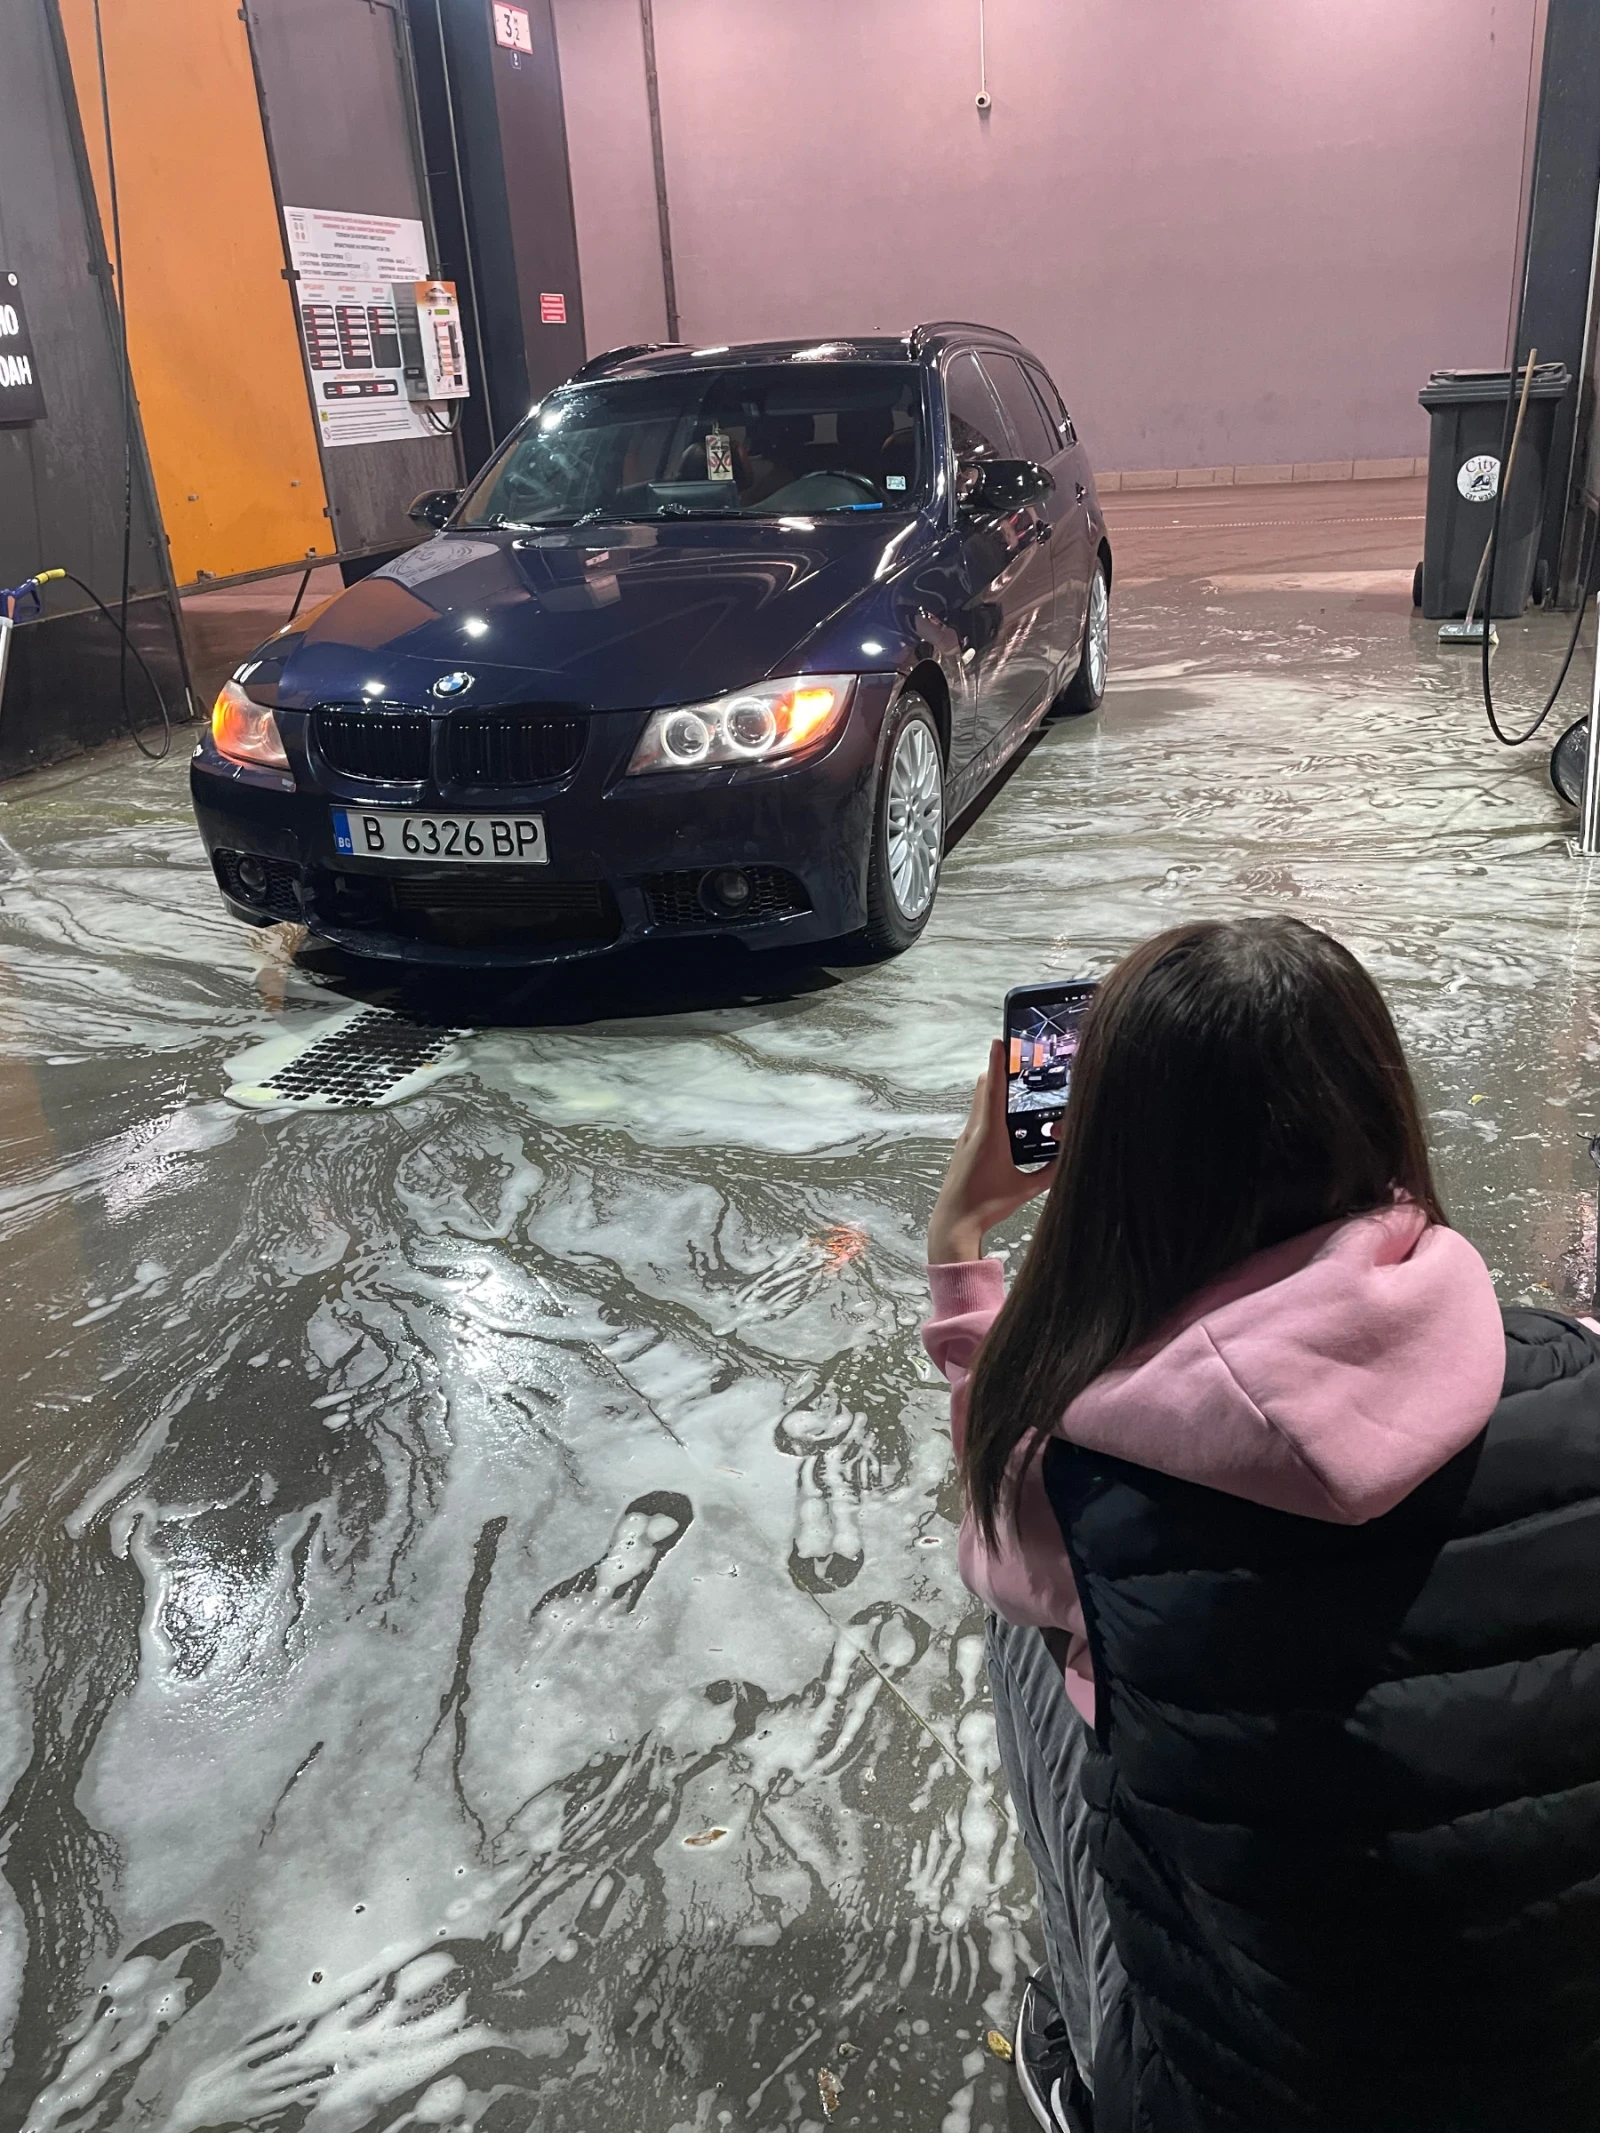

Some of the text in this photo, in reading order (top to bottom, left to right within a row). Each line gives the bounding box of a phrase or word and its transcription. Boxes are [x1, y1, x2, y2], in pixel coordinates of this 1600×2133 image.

[504, 14, 512, 37] 3
[1466, 458, 1497, 472] City
[338, 836, 351, 849] BG
[362, 815, 538, 857] B 6326 BP
